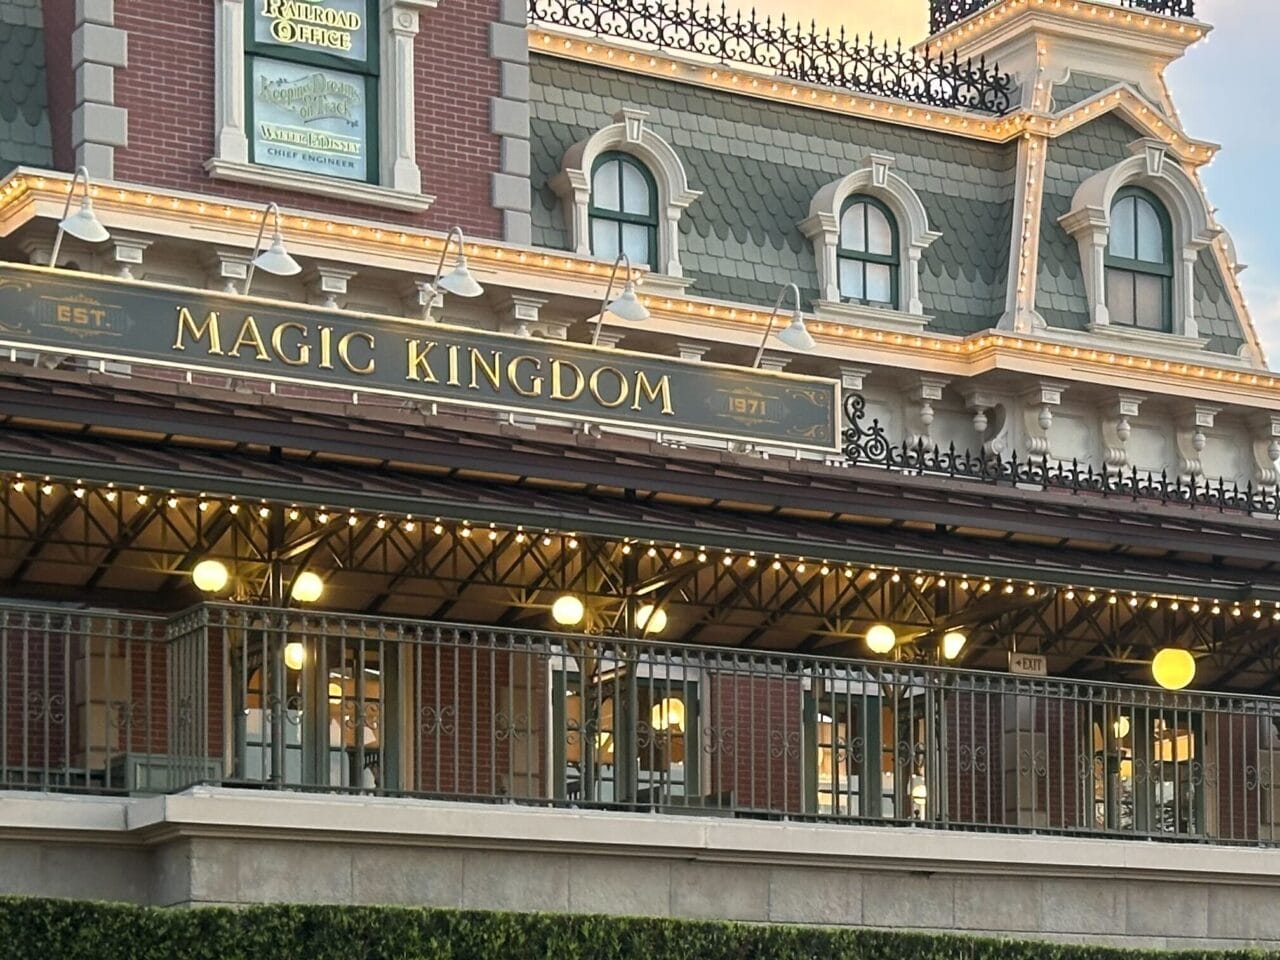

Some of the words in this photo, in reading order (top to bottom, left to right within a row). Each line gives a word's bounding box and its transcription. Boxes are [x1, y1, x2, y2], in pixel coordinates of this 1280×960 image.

[262, 0, 361, 30] RAILROAD
[270, 19, 352, 51] OFFICE
[267, 148, 298, 159] CHIEF
[302, 153, 355, 169] ENGINEER
[56, 304, 111, 328] EST.
[172, 305, 376, 375] MAGIC
[405, 338, 676, 416] KINGDOM
[729, 396, 766, 416] 1971
[1022, 657, 1042, 672] EXIT
